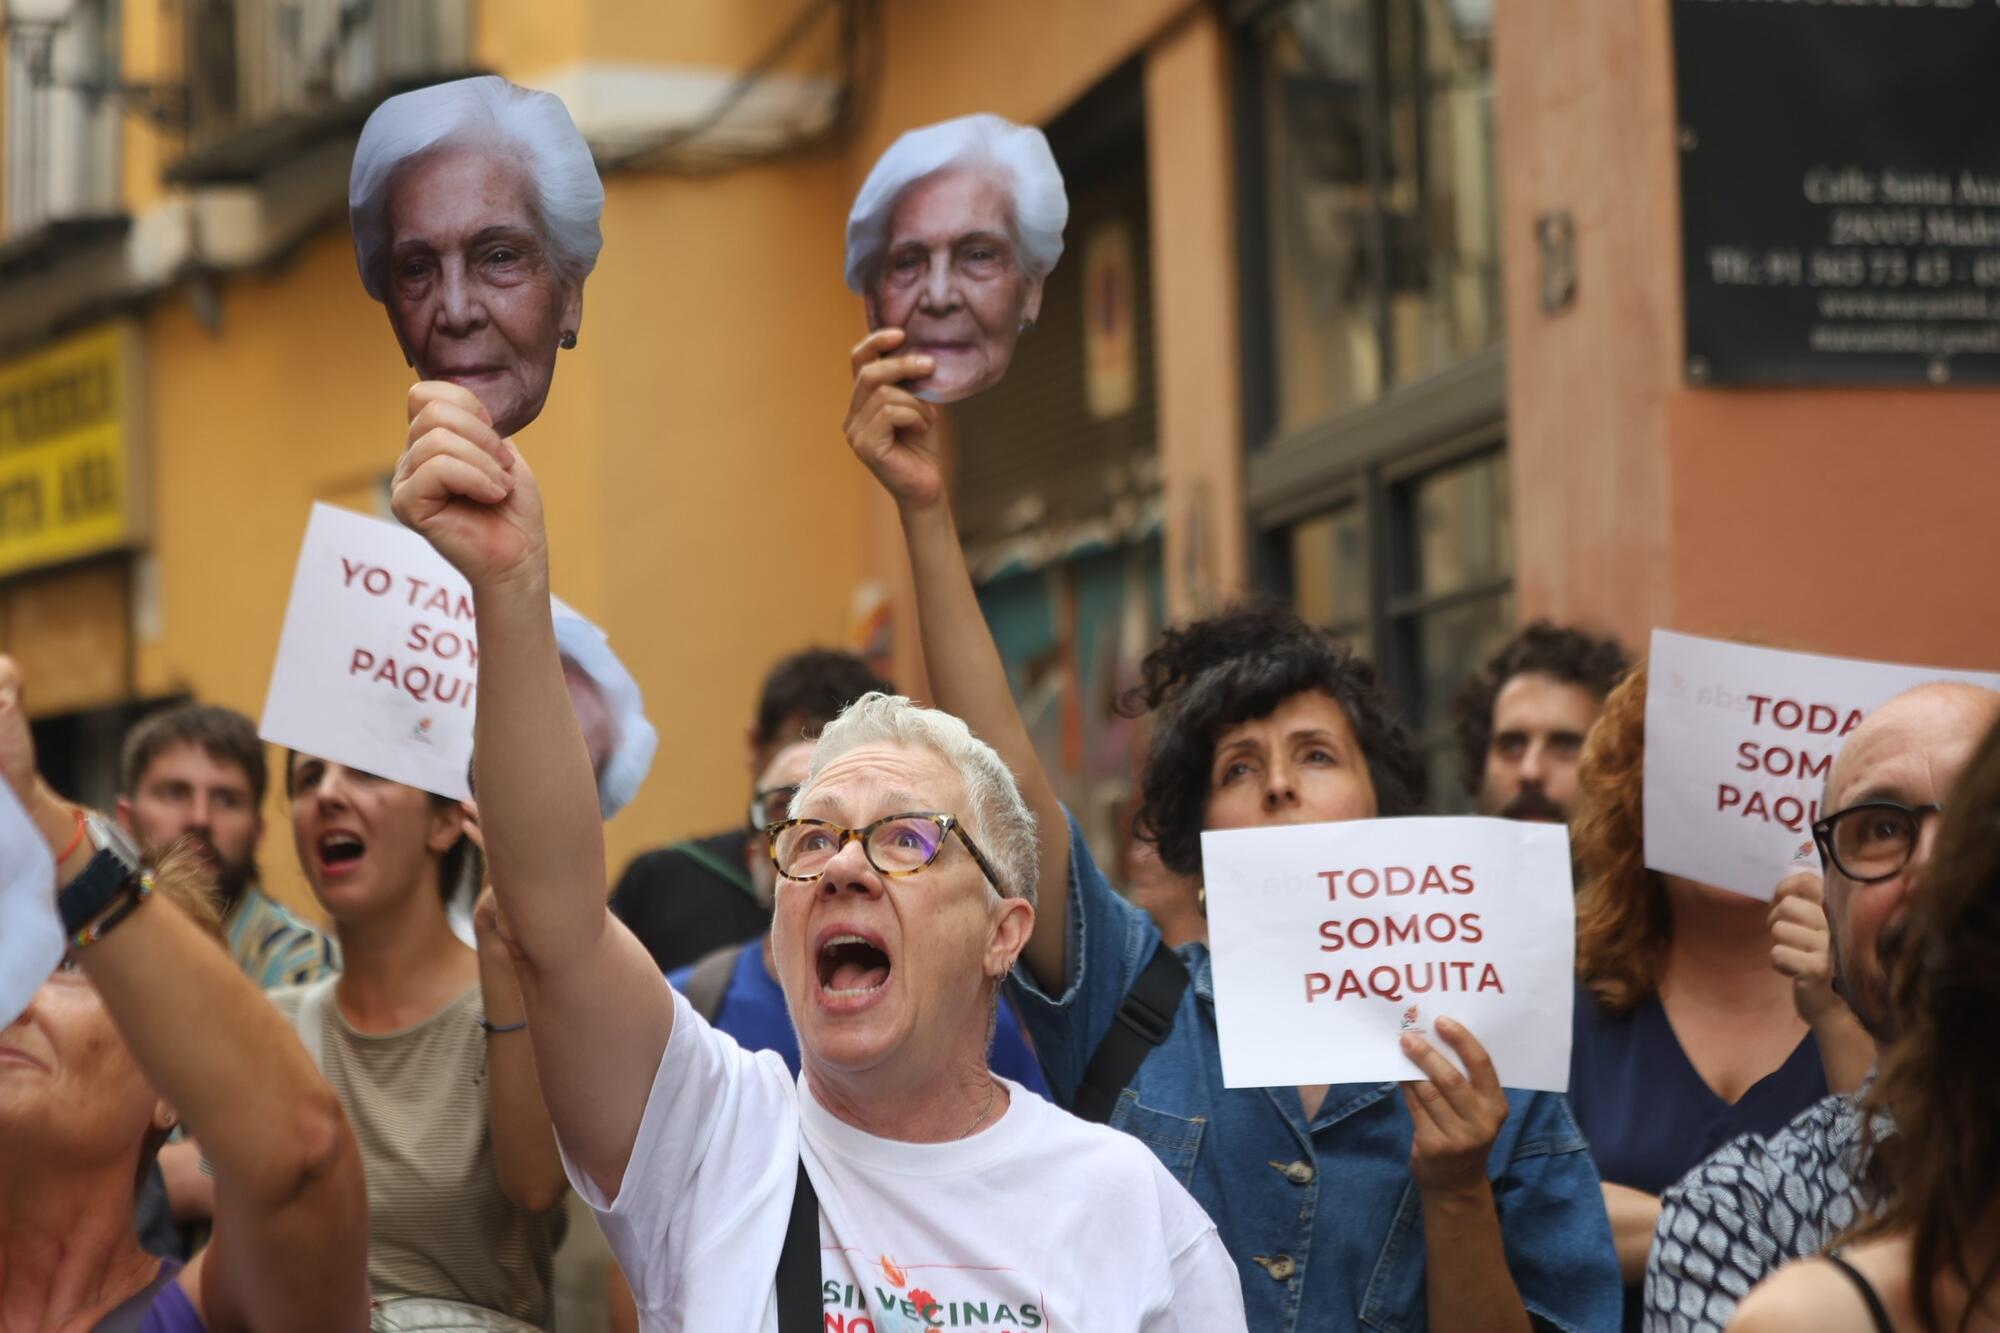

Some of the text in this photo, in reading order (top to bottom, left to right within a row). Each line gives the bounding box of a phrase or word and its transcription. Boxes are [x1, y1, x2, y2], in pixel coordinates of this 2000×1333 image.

[341, 557, 392, 596] YO
[407, 623, 478, 668] SOY
[1317, 864, 1474, 901] TODAS
[1319, 912, 1483, 952] SOMOS
[1304, 961, 1504, 1003] PAQUITA
[874, 1286, 1042, 1328] VECINAS
